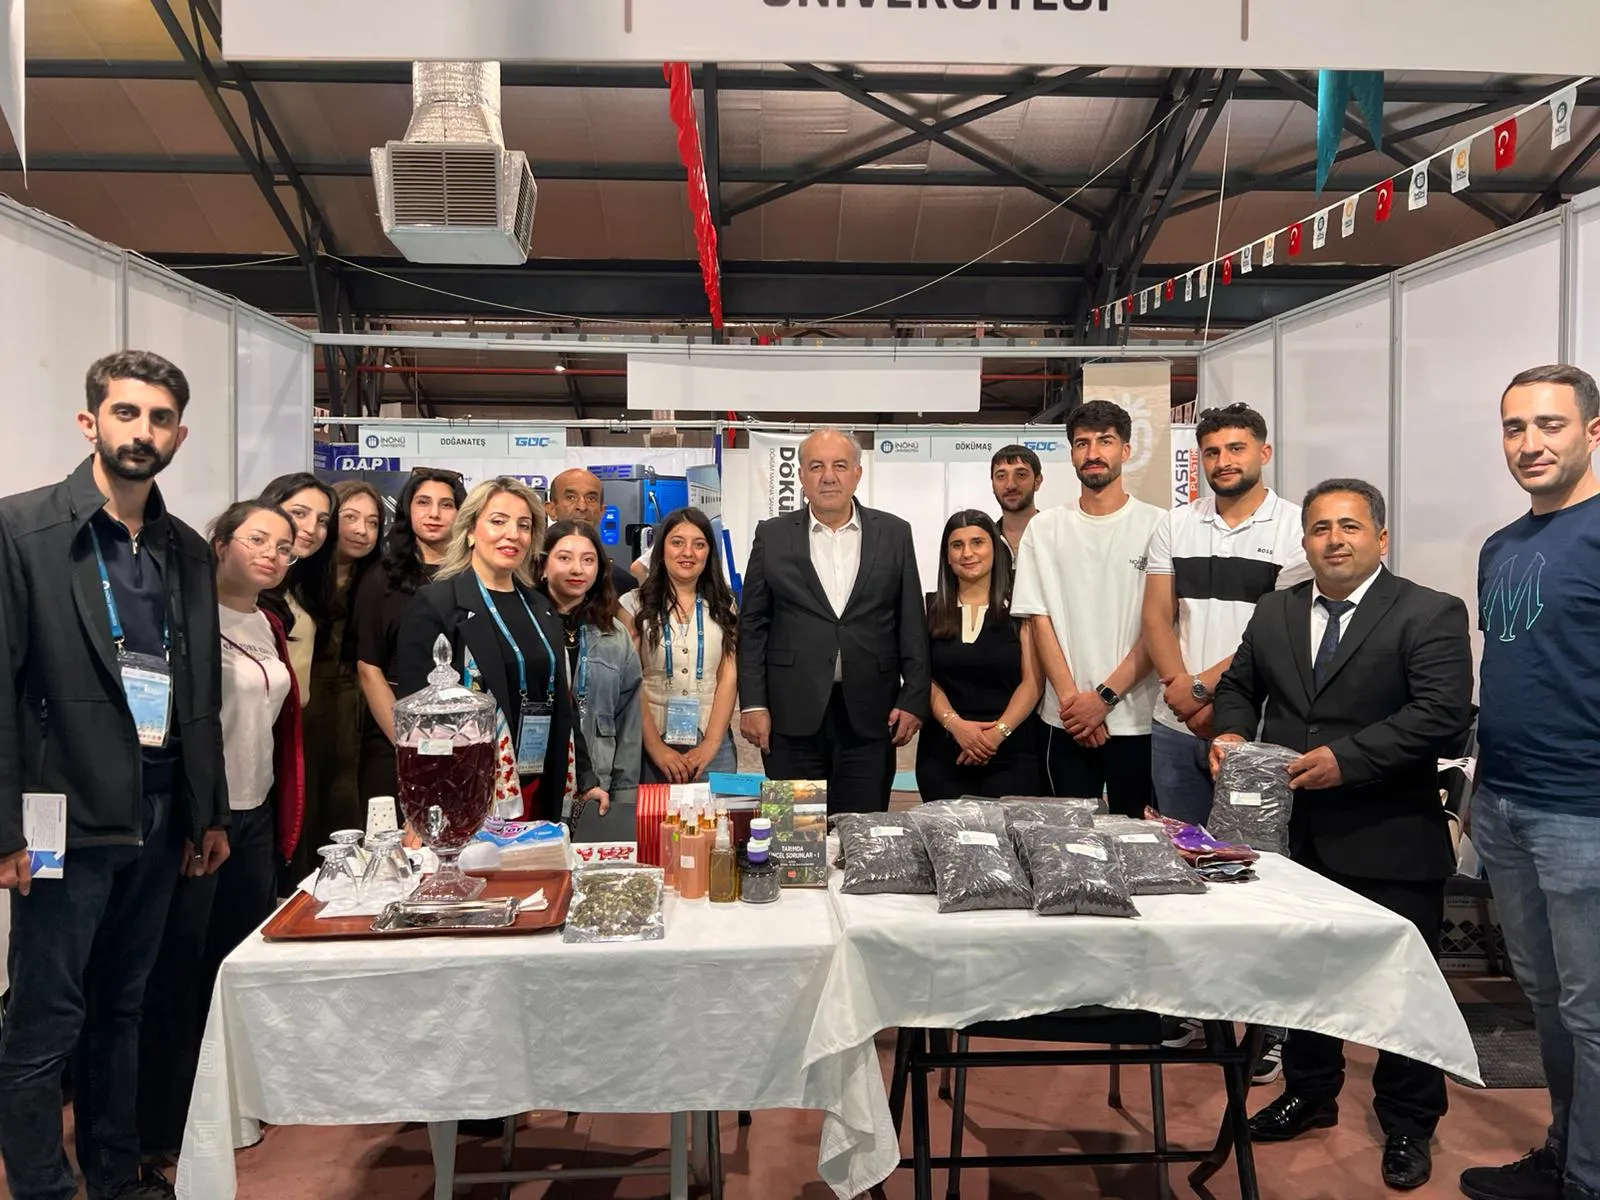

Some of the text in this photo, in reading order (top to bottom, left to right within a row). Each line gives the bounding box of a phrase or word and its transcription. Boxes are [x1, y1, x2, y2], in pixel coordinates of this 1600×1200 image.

[440, 437, 486, 448] DOĞANATEŞ
[956, 441, 993, 452] DÖKÜMAŞ
[341, 458, 384, 471] D.A.P
[779, 447, 796, 513] DÖKÜ
[786, 851, 813, 859] SORUNLAR
